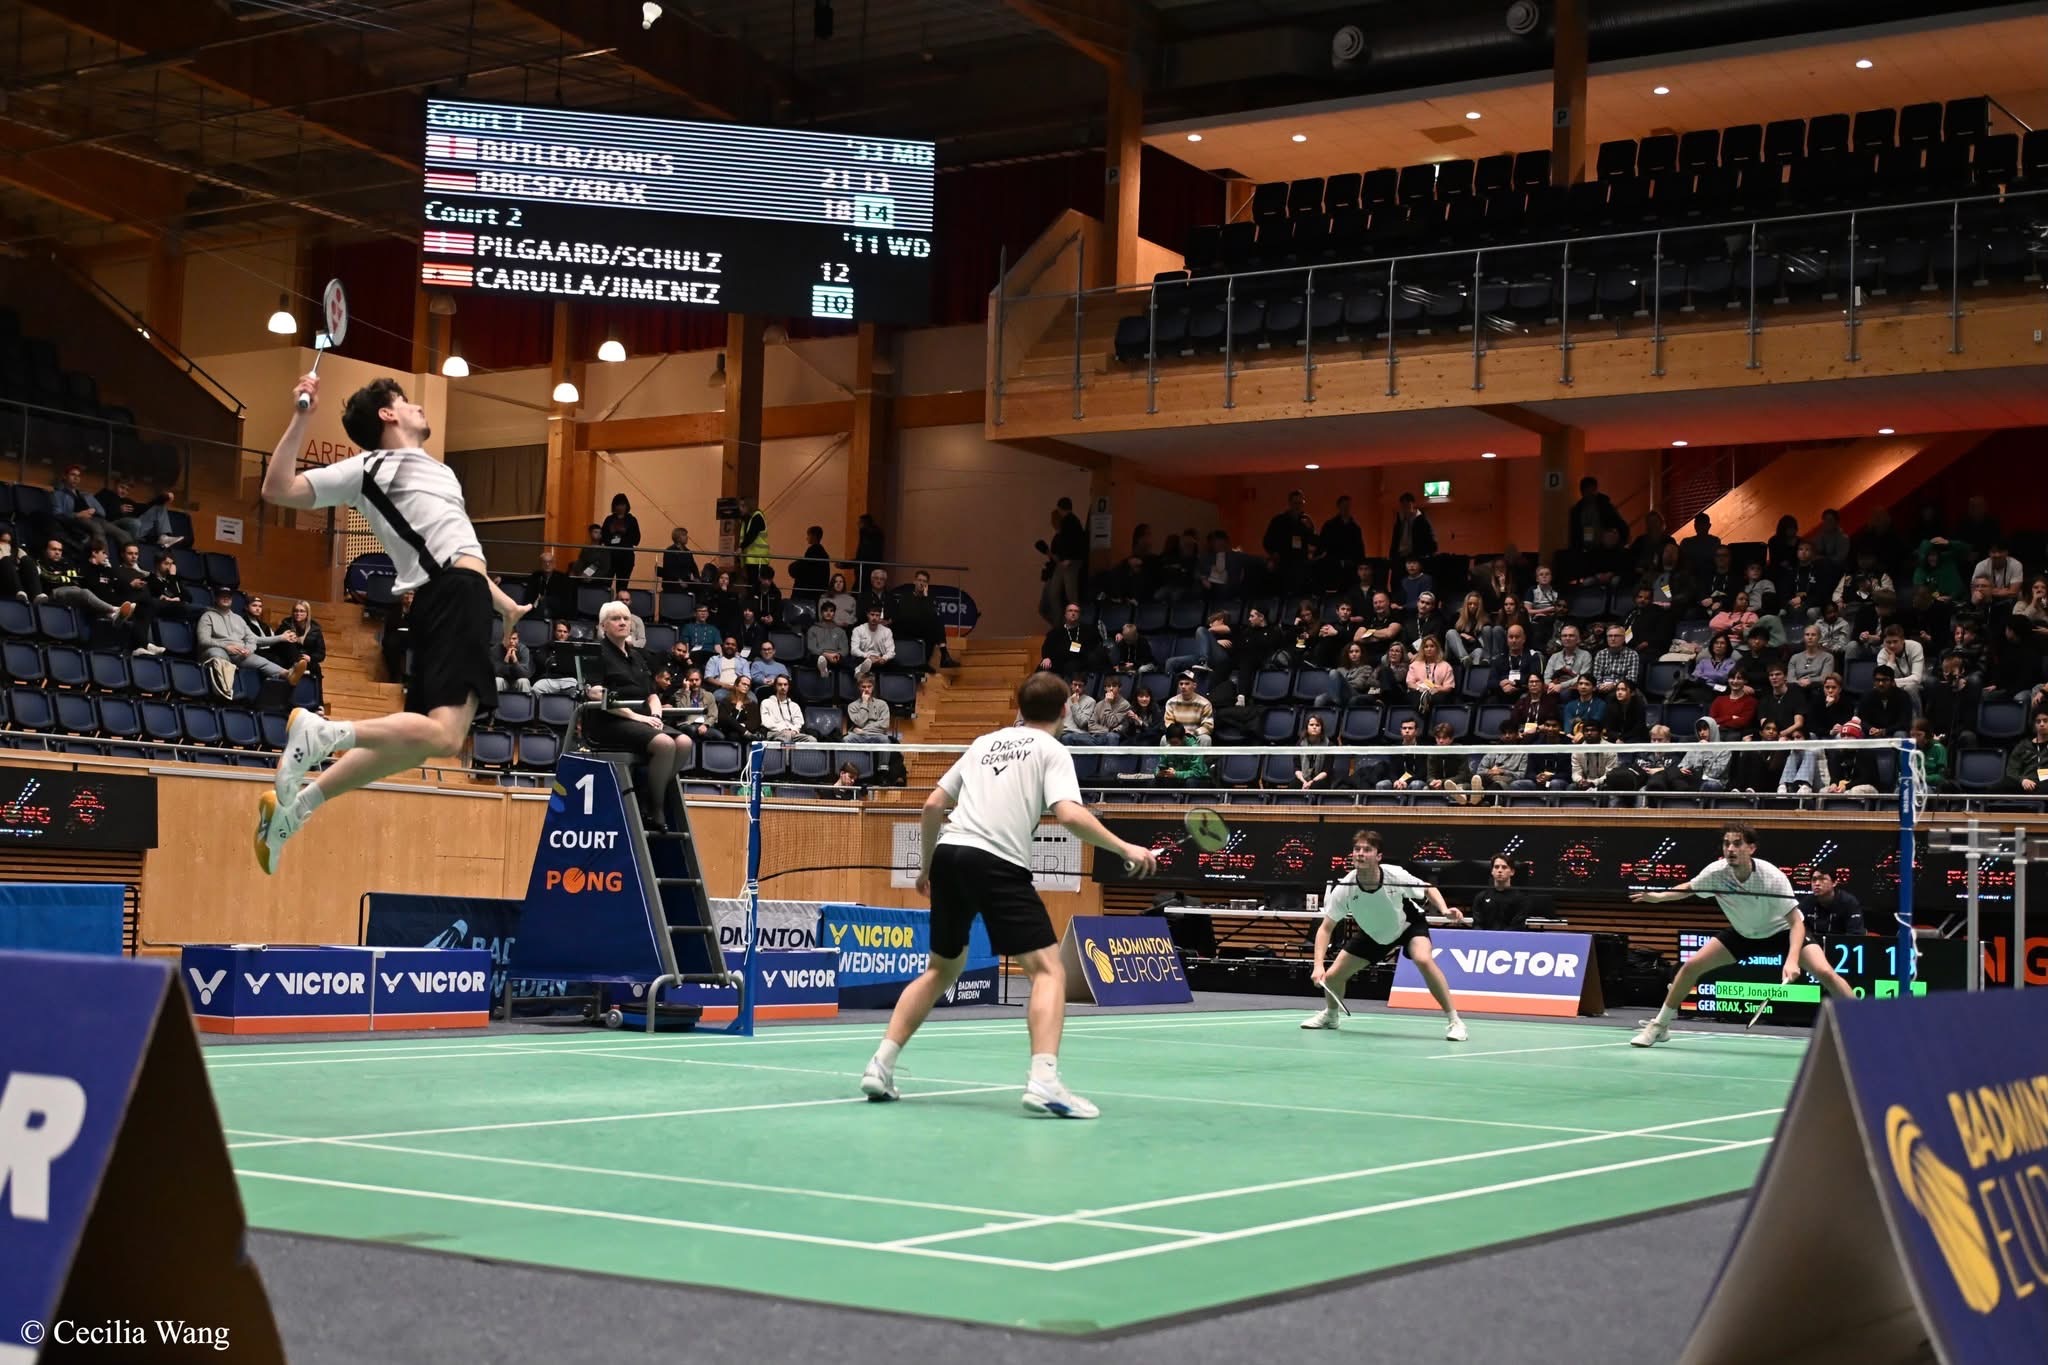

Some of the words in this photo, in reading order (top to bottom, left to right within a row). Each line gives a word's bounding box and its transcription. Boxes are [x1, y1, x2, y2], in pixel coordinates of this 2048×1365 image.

[480, 138, 675, 176] BUTLER/JONES
[480, 171, 648, 205] DRESP/KRAX
[820, 169, 850, 190] 21
[425, 201, 499, 226] Court
[506, 208, 523, 227] 2
[864, 204, 889, 222] 14
[477, 234, 723, 274] PILGAARD/SCHULZ
[887, 236, 931, 258] WD
[820, 262, 850, 283] 12
[475, 267, 721, 305] CARULLA/JIMENEZ
[823, 295, 849, 314] 10
[990, 738, 1034, 752] DRESP
[981, 750, 1031, 765] GERMANY
[575, 774, 594, 815] 1
[550, 831, 618, 849] COURT
[545, 867, 623, 894] PONG
[852, 924, 914, 948] VICTOR
[1108, 937, 1174, 956] BADMINTON
[839, 952, 895, 974] WEDISH
[1113, 956, 1183, 983] EUROPE
[1450, 949, 1579, 978] VICTOR
[1835, 945, 1863, 975] 21
[276, 972, 365, 995] VICTOR
[408, 971, 486, 993] VICTOR
[781, 969, 836, 988] VICTOR
[957, 980, 991, 991] BADMINTON
[957, 990, 980, 1000] SWEDEN
[1698, 984, 1715, 995] GER
[1716, 985, 1745, 998] DRESP,
[1698, 1000, 1715, 1011] GER
[1716, 1000, 1743, 1014] KRAX,
[1744, 1002, 1773, 1014] Simon
